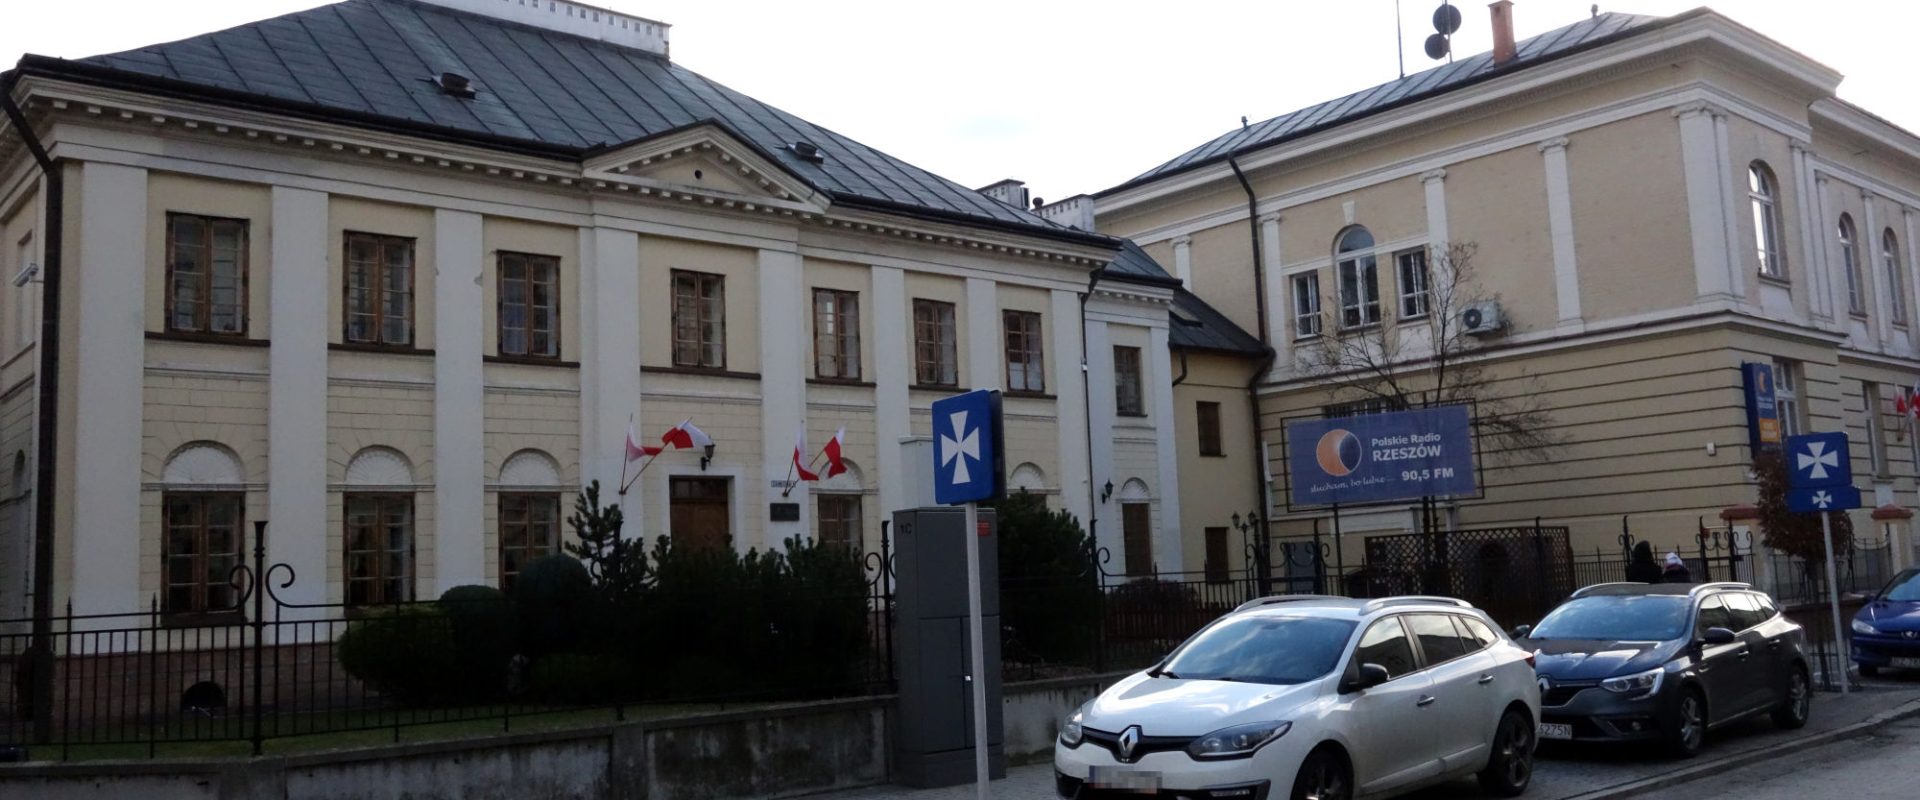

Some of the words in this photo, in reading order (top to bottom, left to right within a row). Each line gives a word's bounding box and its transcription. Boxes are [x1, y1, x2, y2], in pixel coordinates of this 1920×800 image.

[1371, 434, 1408, 447] Polskie
[1410, 432, 1441, 444] Radio
[1372, 443, 1441, 462] RZESZÓW
[1401, 469, 1430, 482] 90,5
[1433, 467, 1454, 479] FM
